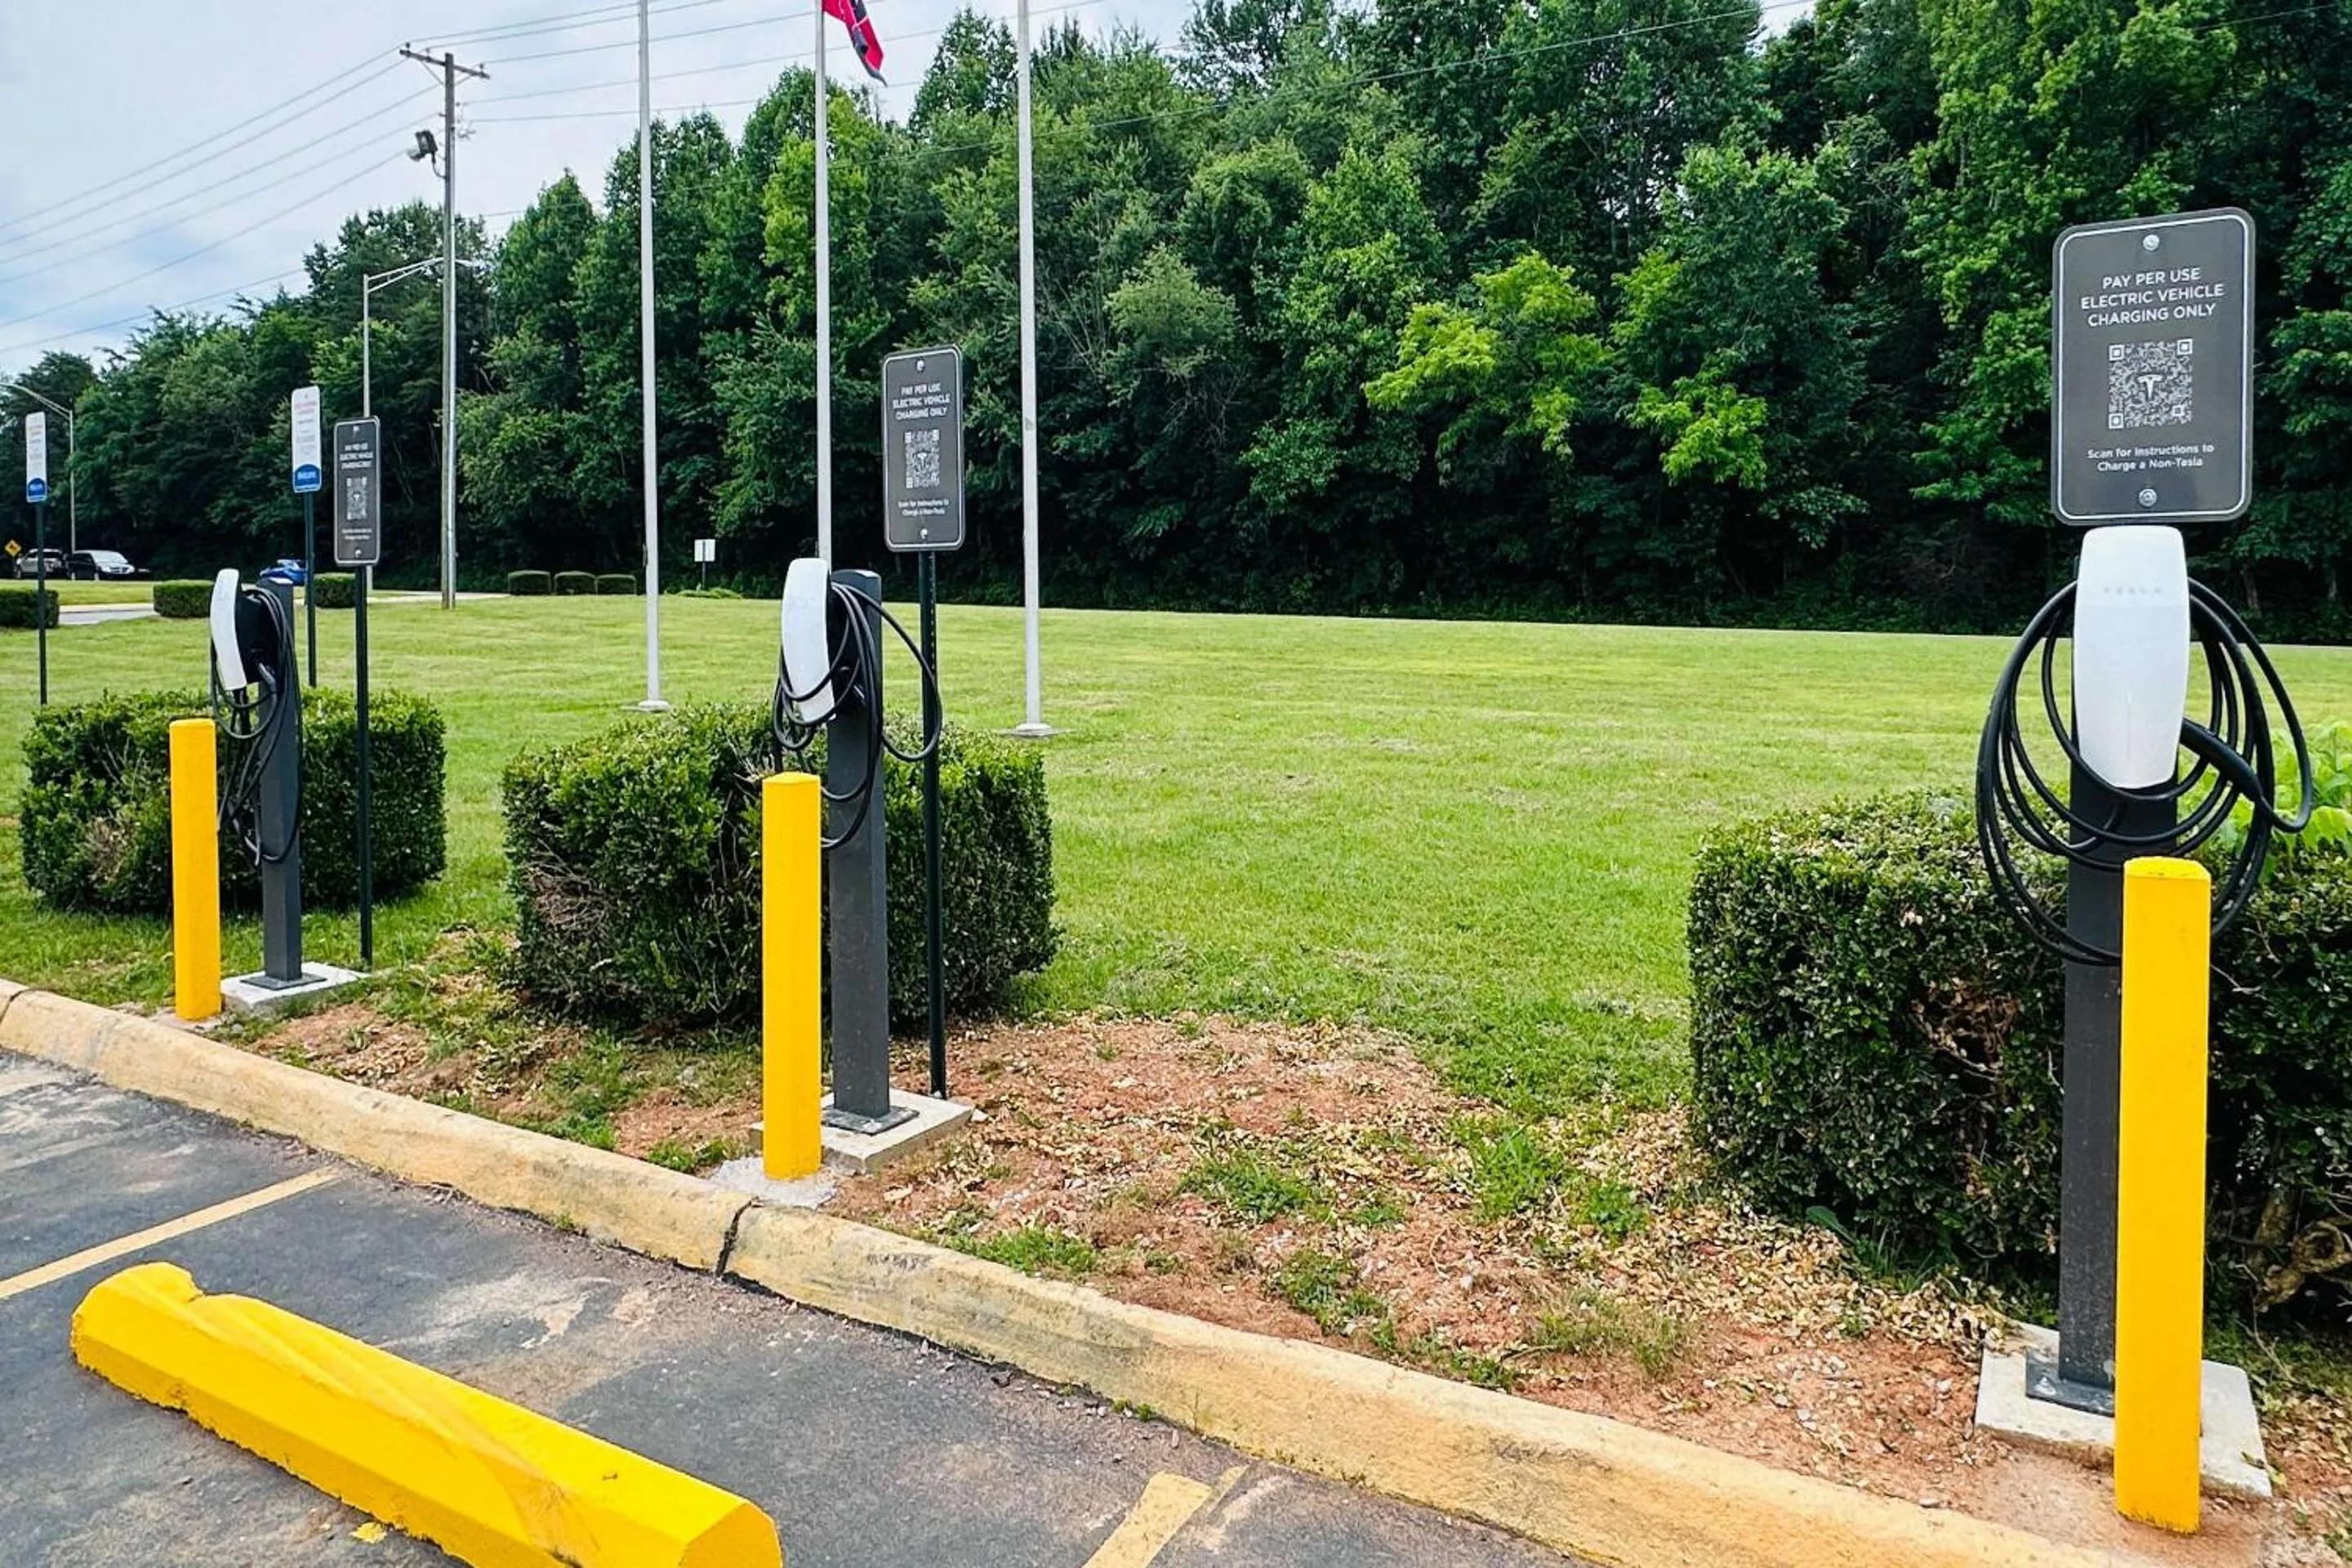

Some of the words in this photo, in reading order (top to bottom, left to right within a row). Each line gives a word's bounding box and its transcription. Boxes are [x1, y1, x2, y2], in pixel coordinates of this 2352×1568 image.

[2102, 274, 2132, 289] PAY
[2136, 271, 2165, 285] PER
[2170, 267, 2201, 283] USE
[2081, 291, 2154, 310] ELECTRIC
[2157, 283, 2225, 302] VEHICLE
[2087, 307, 2169, 327] CHARGING
[2173, 303, 2216, 319] ONLY
[2087, 449, 2113, 459] Scan
[2116, 448, 2132, 457] for
[2203, 443, 2214, 452] to
[2097, 461, 2136, 471] Charge
[2149, 457, 2203, 468] Non-Tesla
